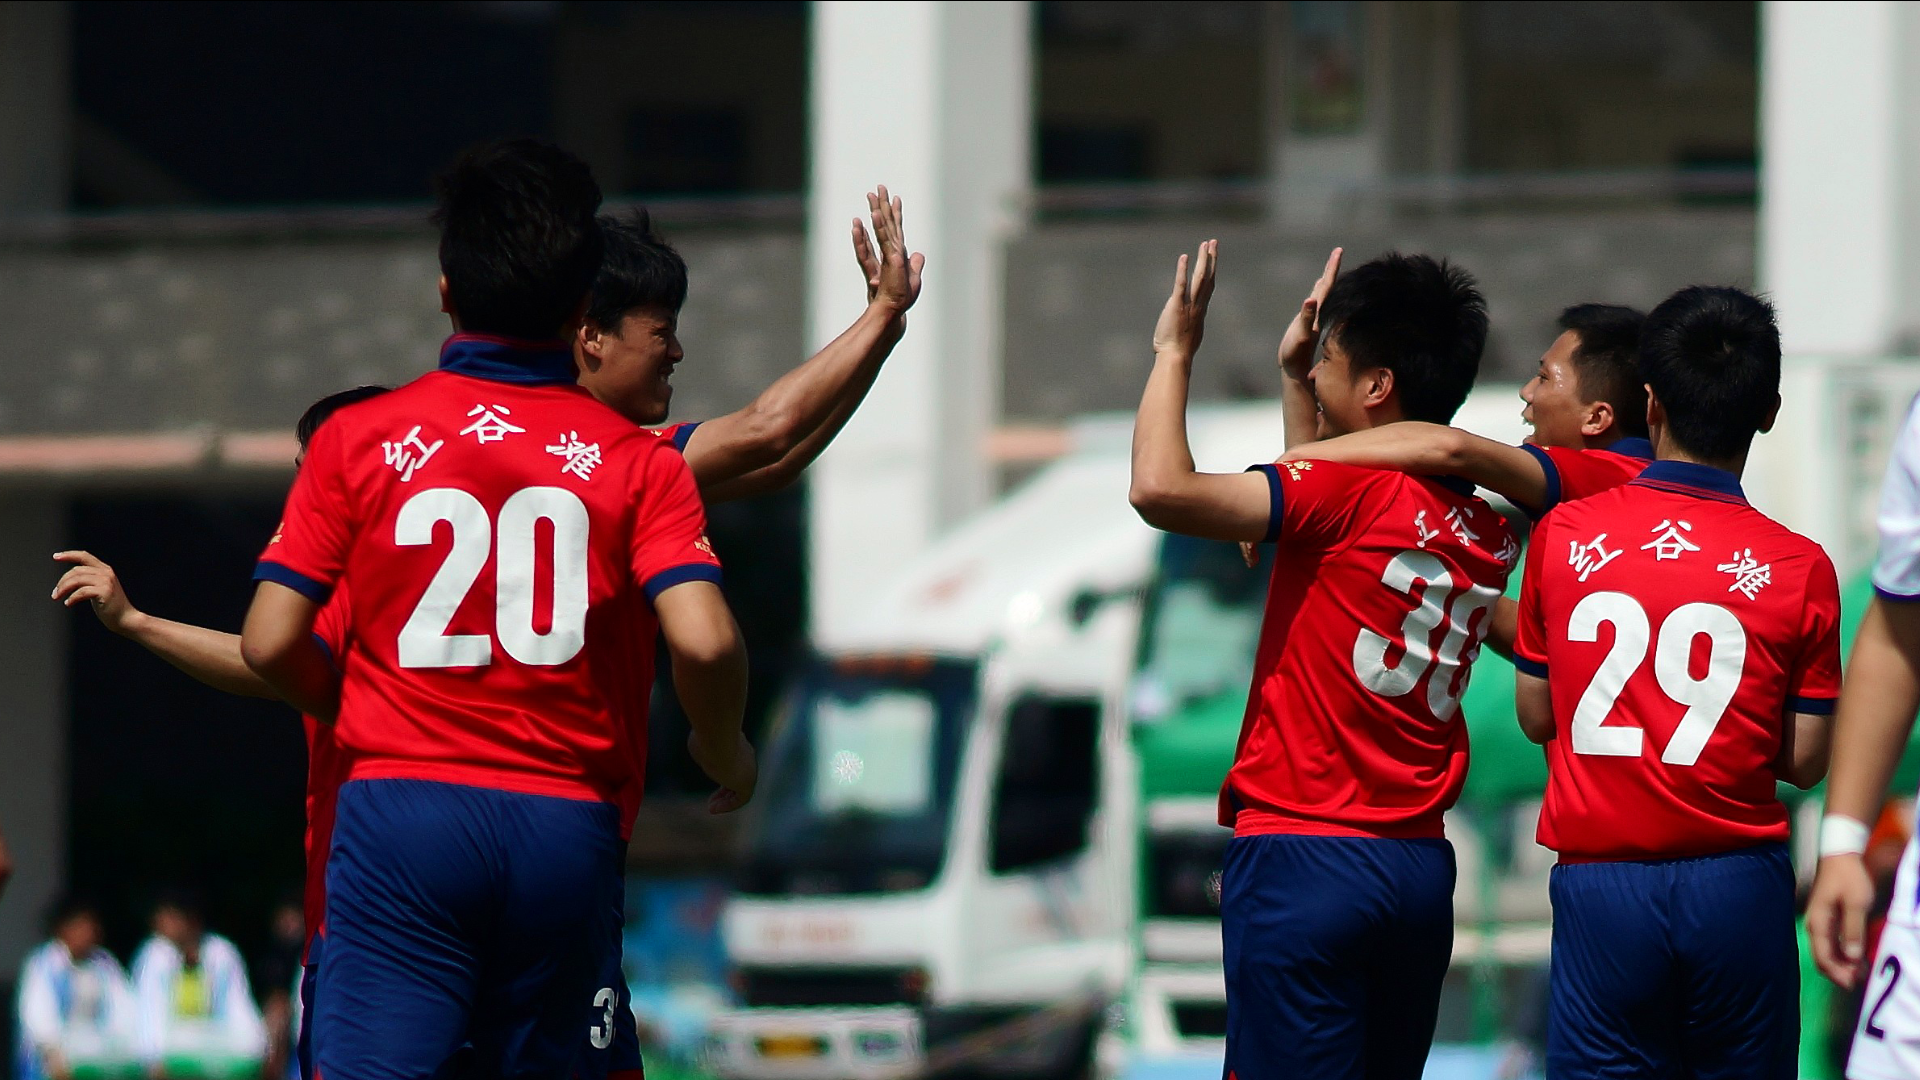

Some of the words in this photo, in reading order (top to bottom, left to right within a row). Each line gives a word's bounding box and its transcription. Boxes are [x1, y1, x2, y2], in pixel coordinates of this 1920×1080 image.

[381, 403, 602, 482] 红谷滩
[395, 486, 590, 668] 20
[1568, 518, 1772, 601] 红谷滩
[1567, 591, 1747, 766] 29
[590, 987, 619, 1049] 3
[1865, 955, 1901, 1040] 2
